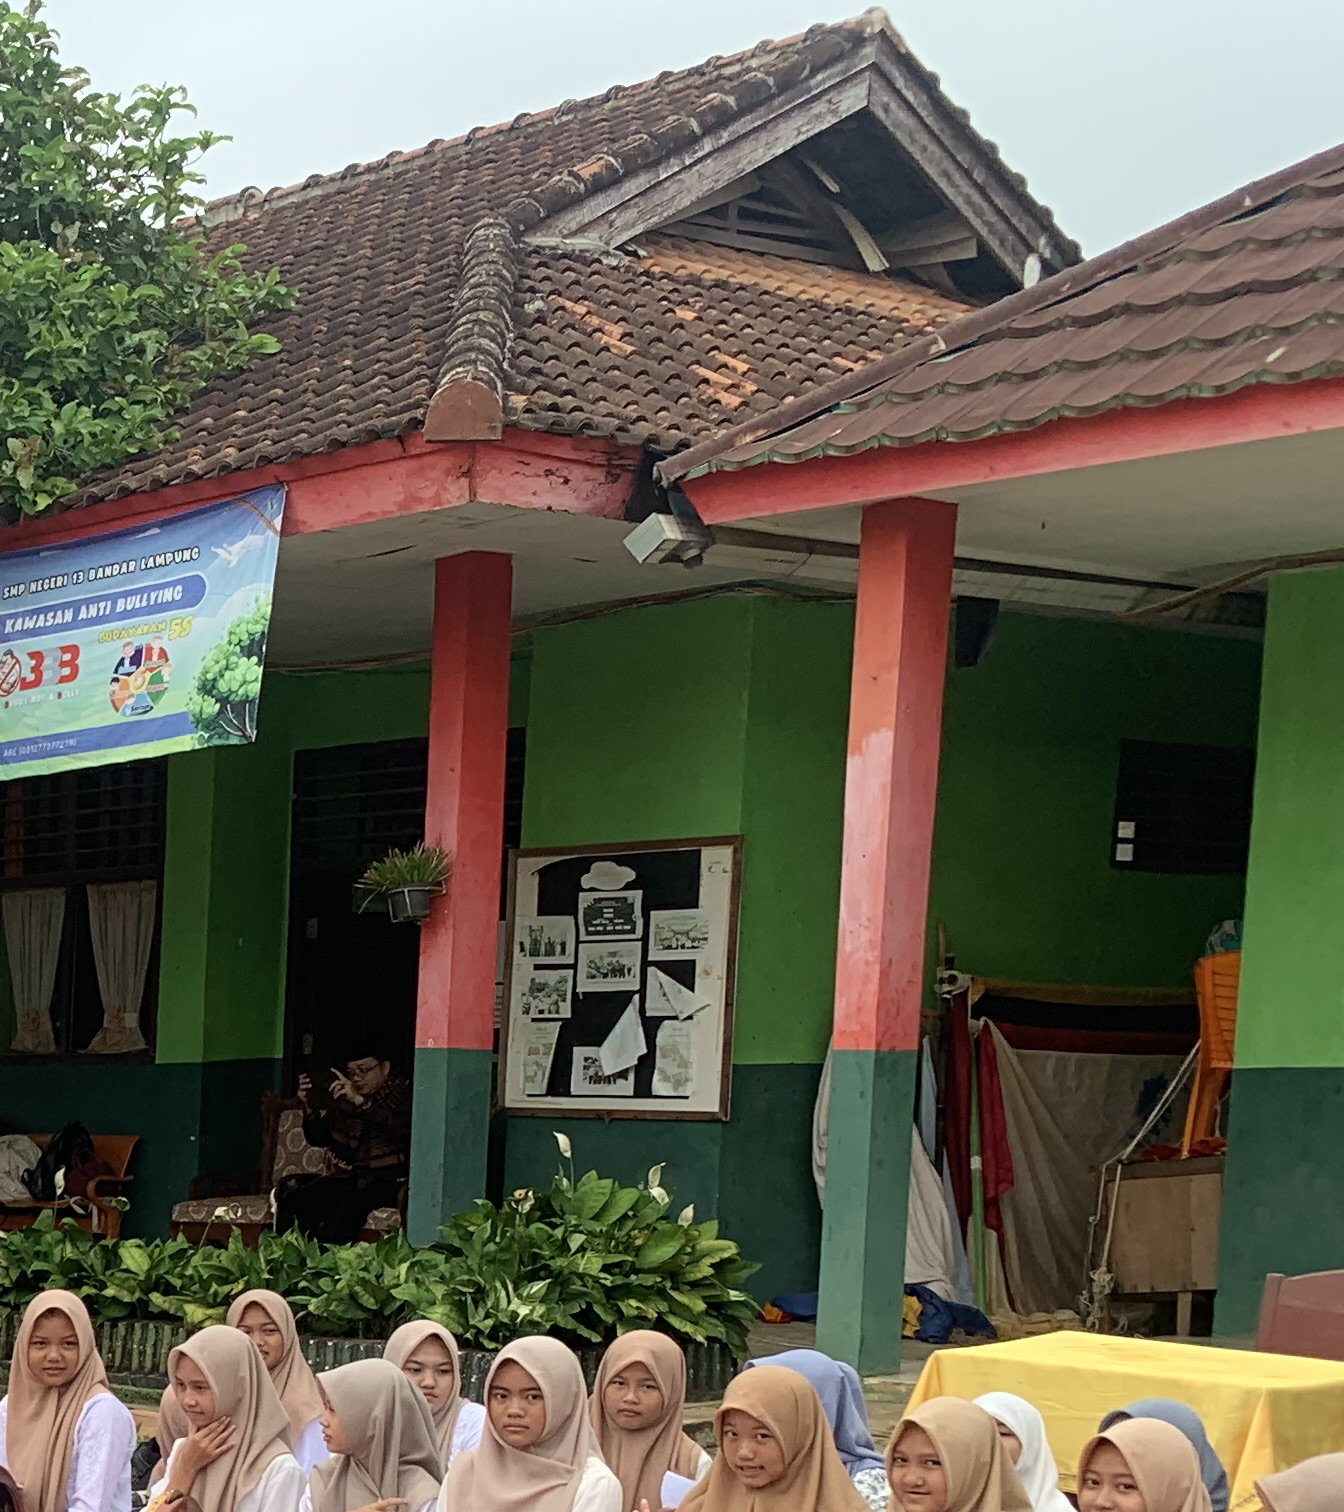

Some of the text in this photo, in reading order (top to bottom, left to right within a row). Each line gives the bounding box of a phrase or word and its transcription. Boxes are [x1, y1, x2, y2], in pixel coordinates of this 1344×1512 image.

[2, 546, 201, 600] SMP NEGERI 13 BANDAR LAMPUNG
[4, 610, 73, 634] KAWASAN
[78, 600, 111, 621] ANTI
[115, 584, 183, 613] BULLYING
[168, 614, 194, 641] 5S
